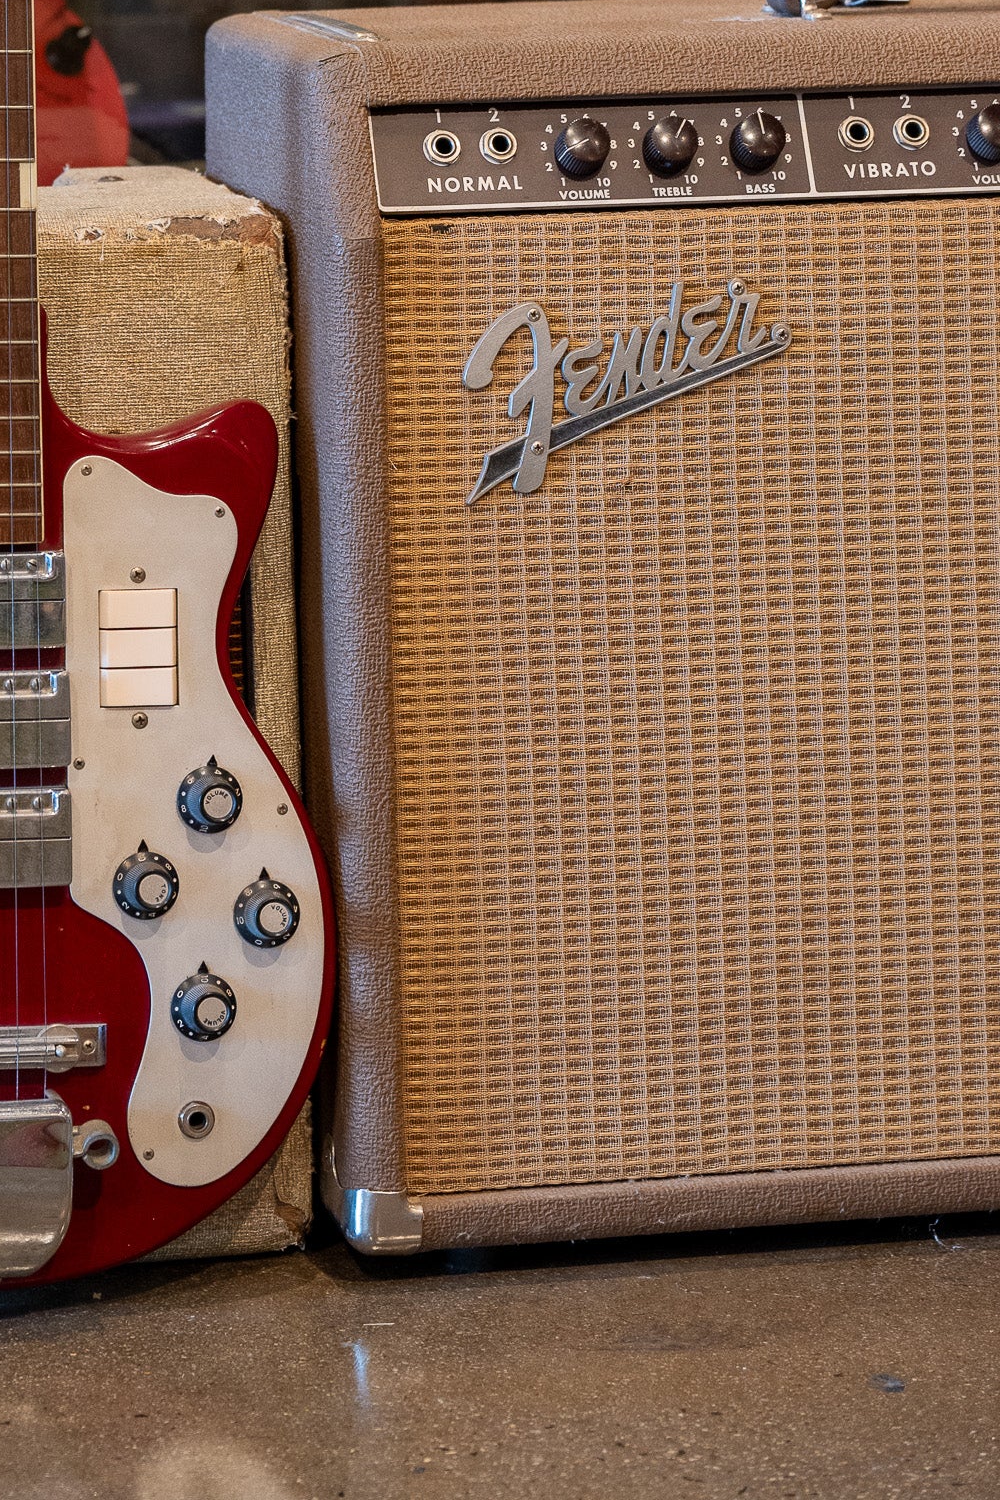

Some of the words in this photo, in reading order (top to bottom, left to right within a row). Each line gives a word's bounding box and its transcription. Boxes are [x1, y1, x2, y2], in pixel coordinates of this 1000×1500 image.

[848, 95, 855, 110] 1
[900, 94, 911, 109] 2
[435, 108, 441, 124] 1
[488, 107, 500, 122] 2
[772, 170, 786, 181] 10
[843, 160, 937, 179] VIBRATO
[427, 175, 523, 193] NORMAL
[596, 177, 611, 187] 10
[684, 174, 698, 184] 10
[559, 189, 611, 200] VOLUME
[652, 186, 693, 197] TREBLE
[745, 183, 776, 194] BASS
[463, 277, 768, 494] Fender
[205, 790, 229, 805] VOLUME
[270, 905, 288, 928] VOLUME
[203, 1010, 226, 1026] VOLUME
